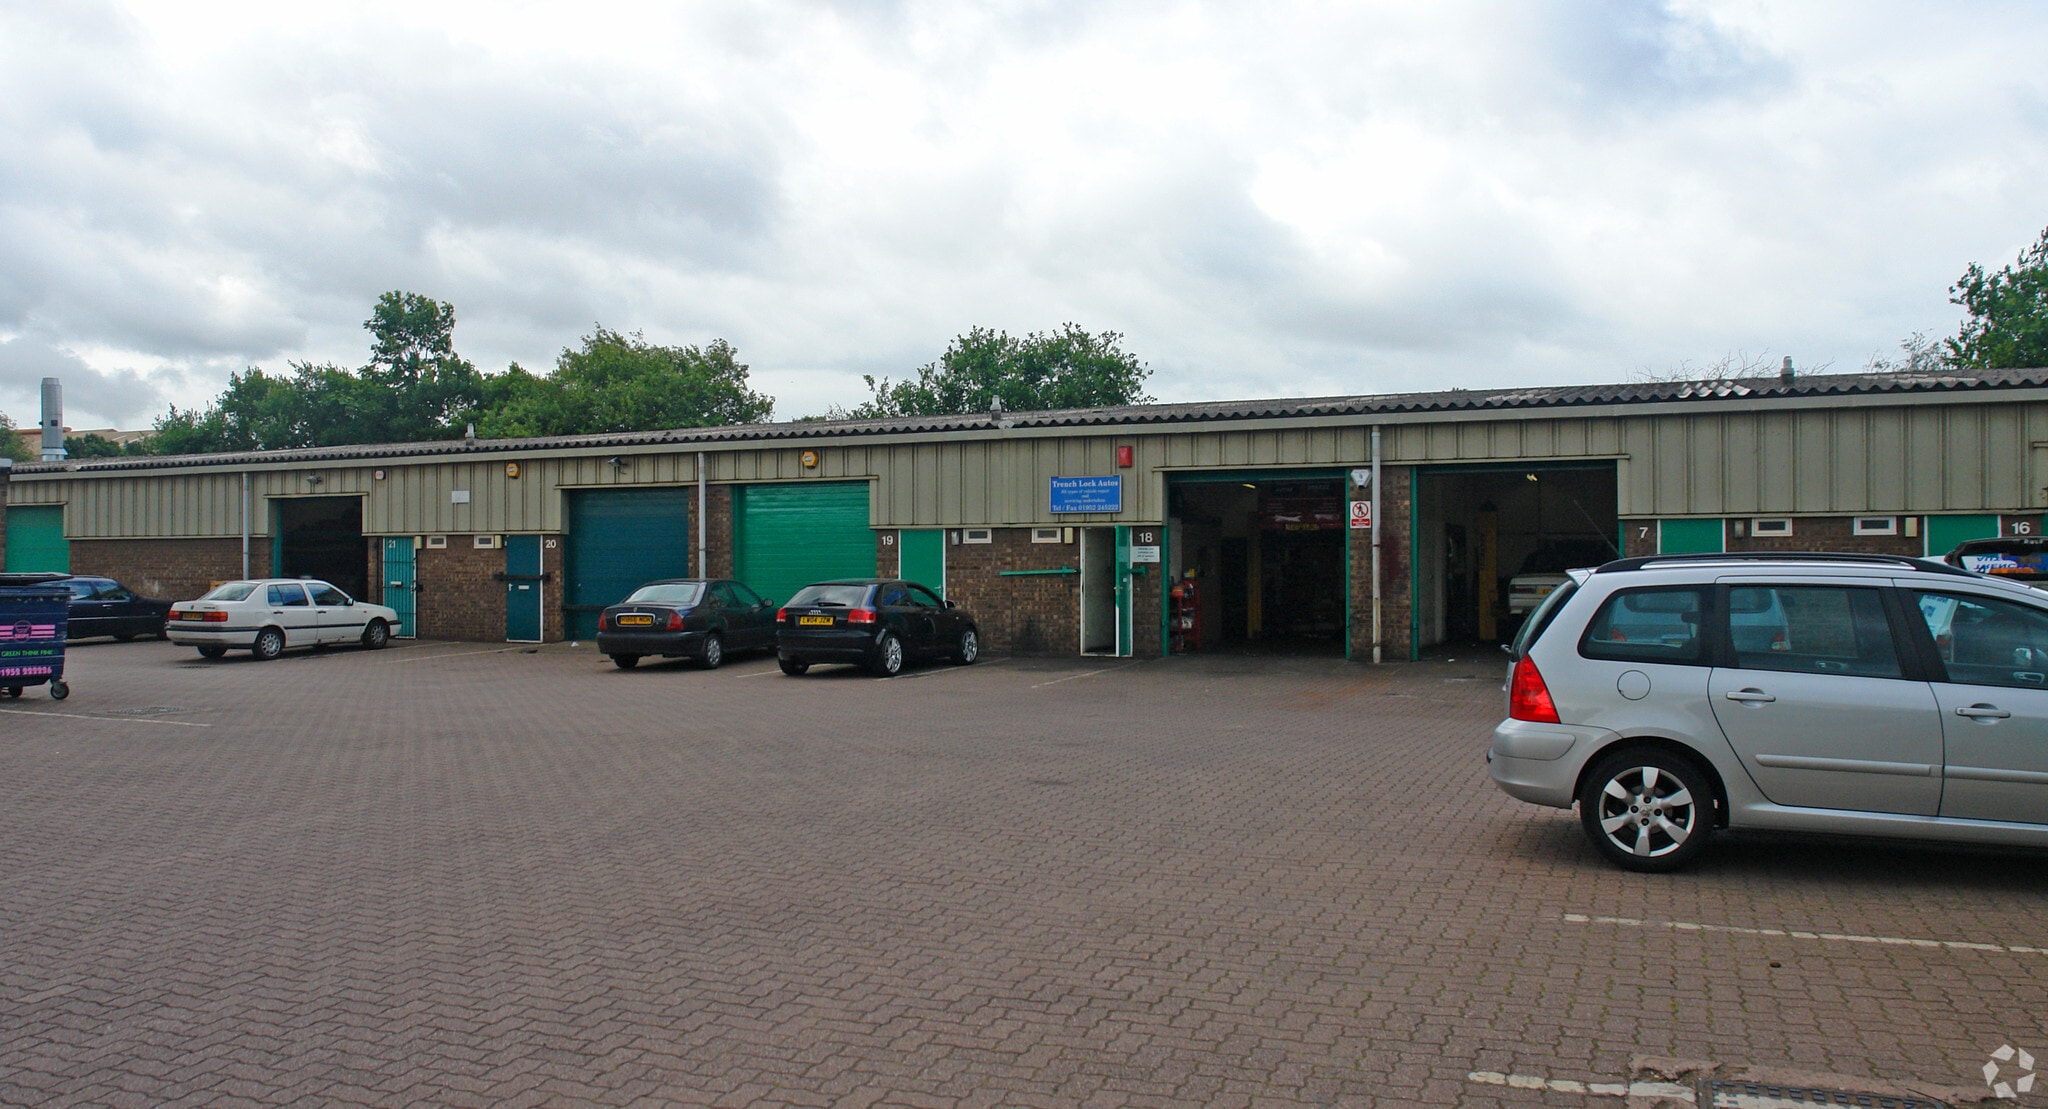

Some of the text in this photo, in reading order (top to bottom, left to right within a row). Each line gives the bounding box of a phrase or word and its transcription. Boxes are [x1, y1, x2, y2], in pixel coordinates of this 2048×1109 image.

[1052, 480, 1077, 488] Trench
[1079, 480, 1097, 488] Lock
[1639, 527, 1648, 538] 7
[2011, 522, 2031, 535] 16
[883, 535, 895, 545] 19
[1139, 532, 1153, 543] 18
[389, 539, 396, 548] 21
[545, 539, 557, 548] 20
